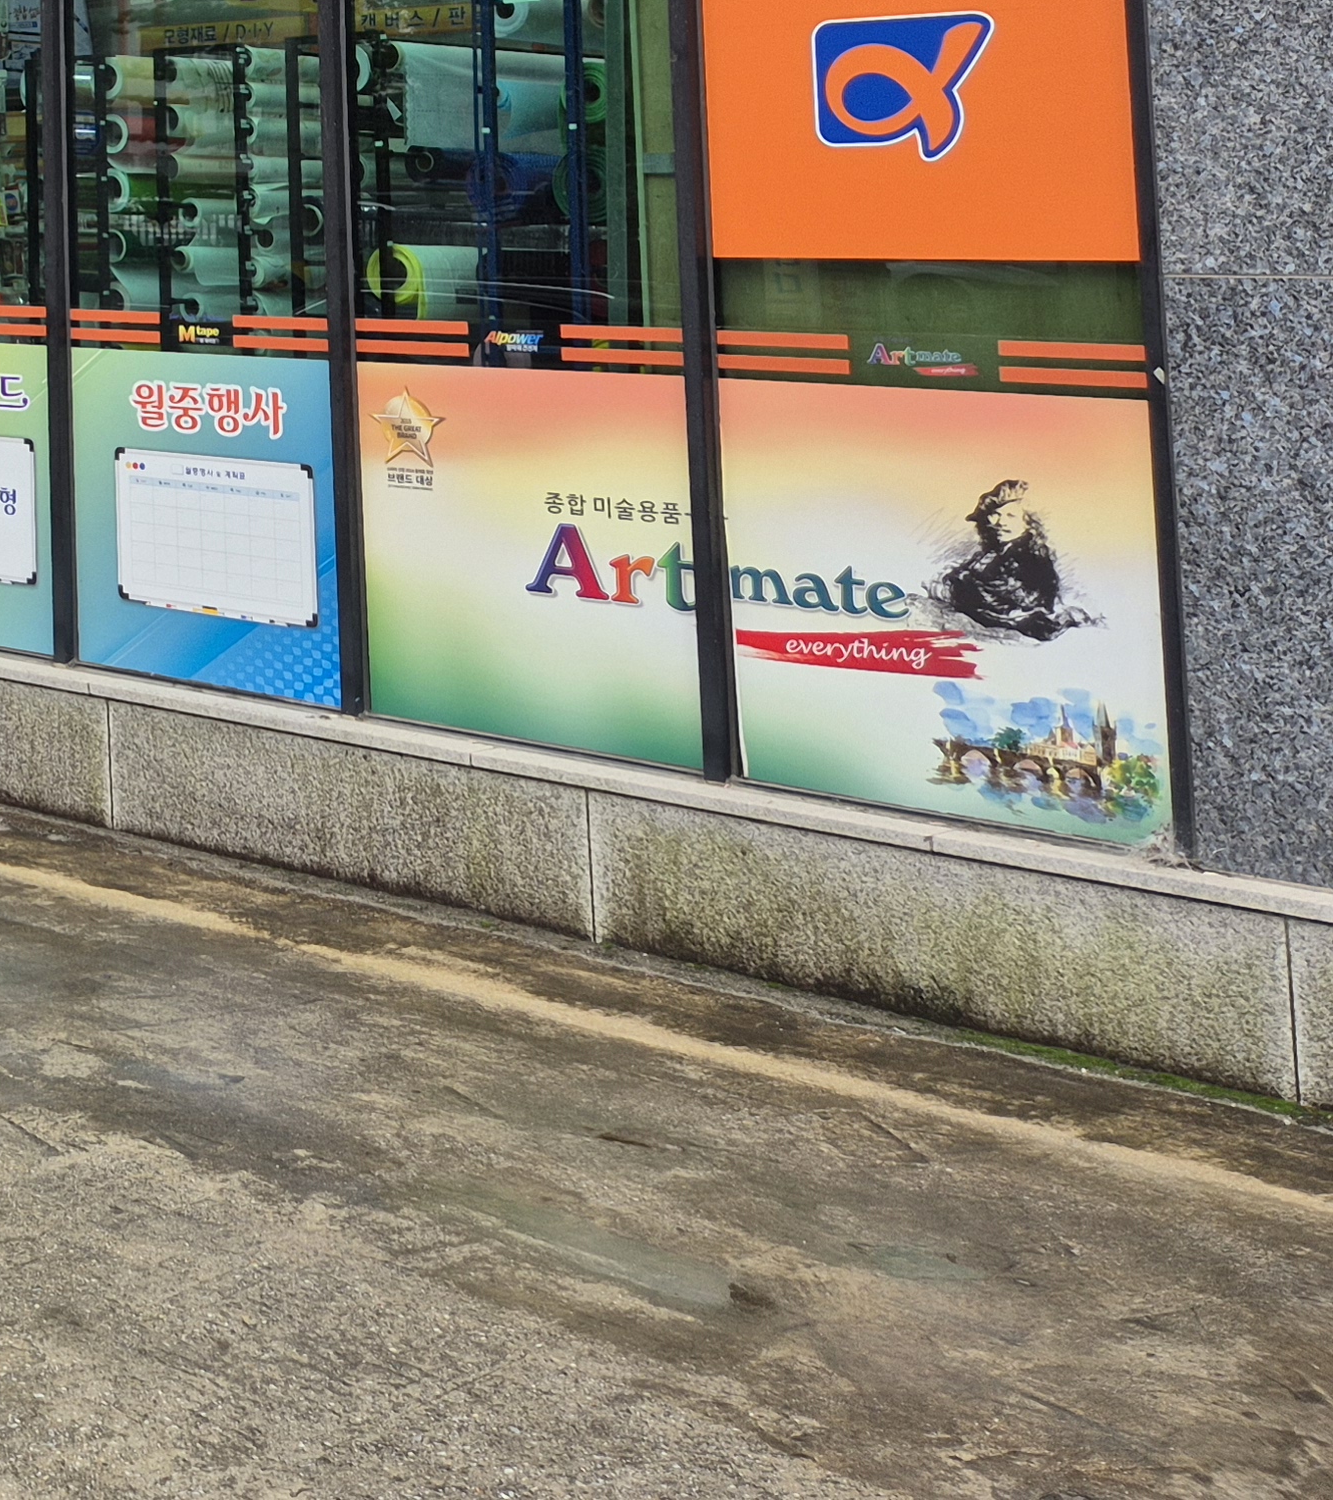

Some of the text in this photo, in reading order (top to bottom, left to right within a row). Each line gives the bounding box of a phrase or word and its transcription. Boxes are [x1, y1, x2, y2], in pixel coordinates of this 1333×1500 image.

[164, 26, 217, 45] 모형재료
[484, 331, 544, 345] Alpower
[131, 380, 287, 439] 월중행사
[397, 432, 417, 440] BRAND
[403, 425, 422, 433] GREAT
[387, 473, 433, 486] 브랜드 대상
[543, 491, 587, 516] 종합
[784, 636, 932, 670] everything
